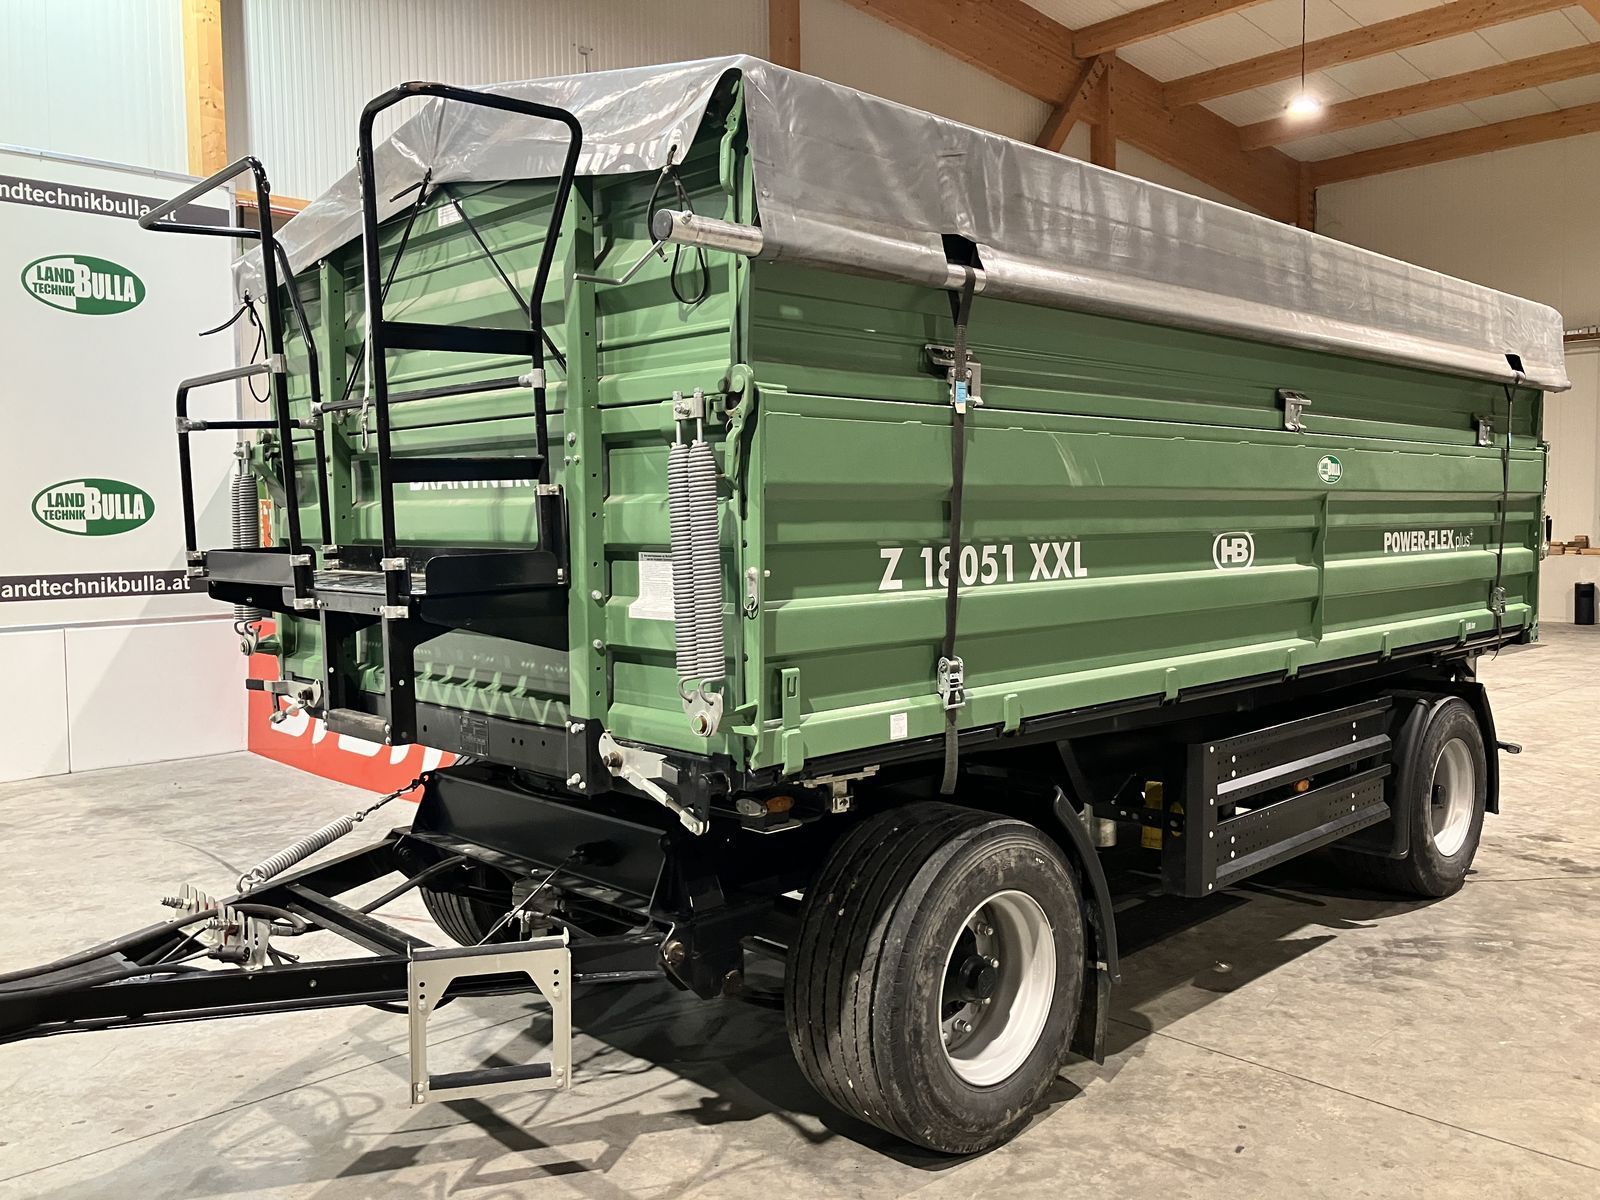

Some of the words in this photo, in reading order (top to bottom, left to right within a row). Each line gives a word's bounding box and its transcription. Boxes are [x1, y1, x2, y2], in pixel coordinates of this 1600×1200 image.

[36, 265, 75, 284] LAND
[74, 264, 137, 303] BULLA
[32, 282, 76, 297] TECHNIK
[47, 492, 85, 508] LAND
[84, 487, 146, 520] BULLA
[43, 509, 86, 521] TECHNIK
[1221, 538, 1249, 563] HB
[878, 547, 904, 591] Z
[920, 544, 1014, 587] 18051
[1029, 541, 1088, 581] XXL
[1, 575, 190, 598] andtechnikbulla.at
